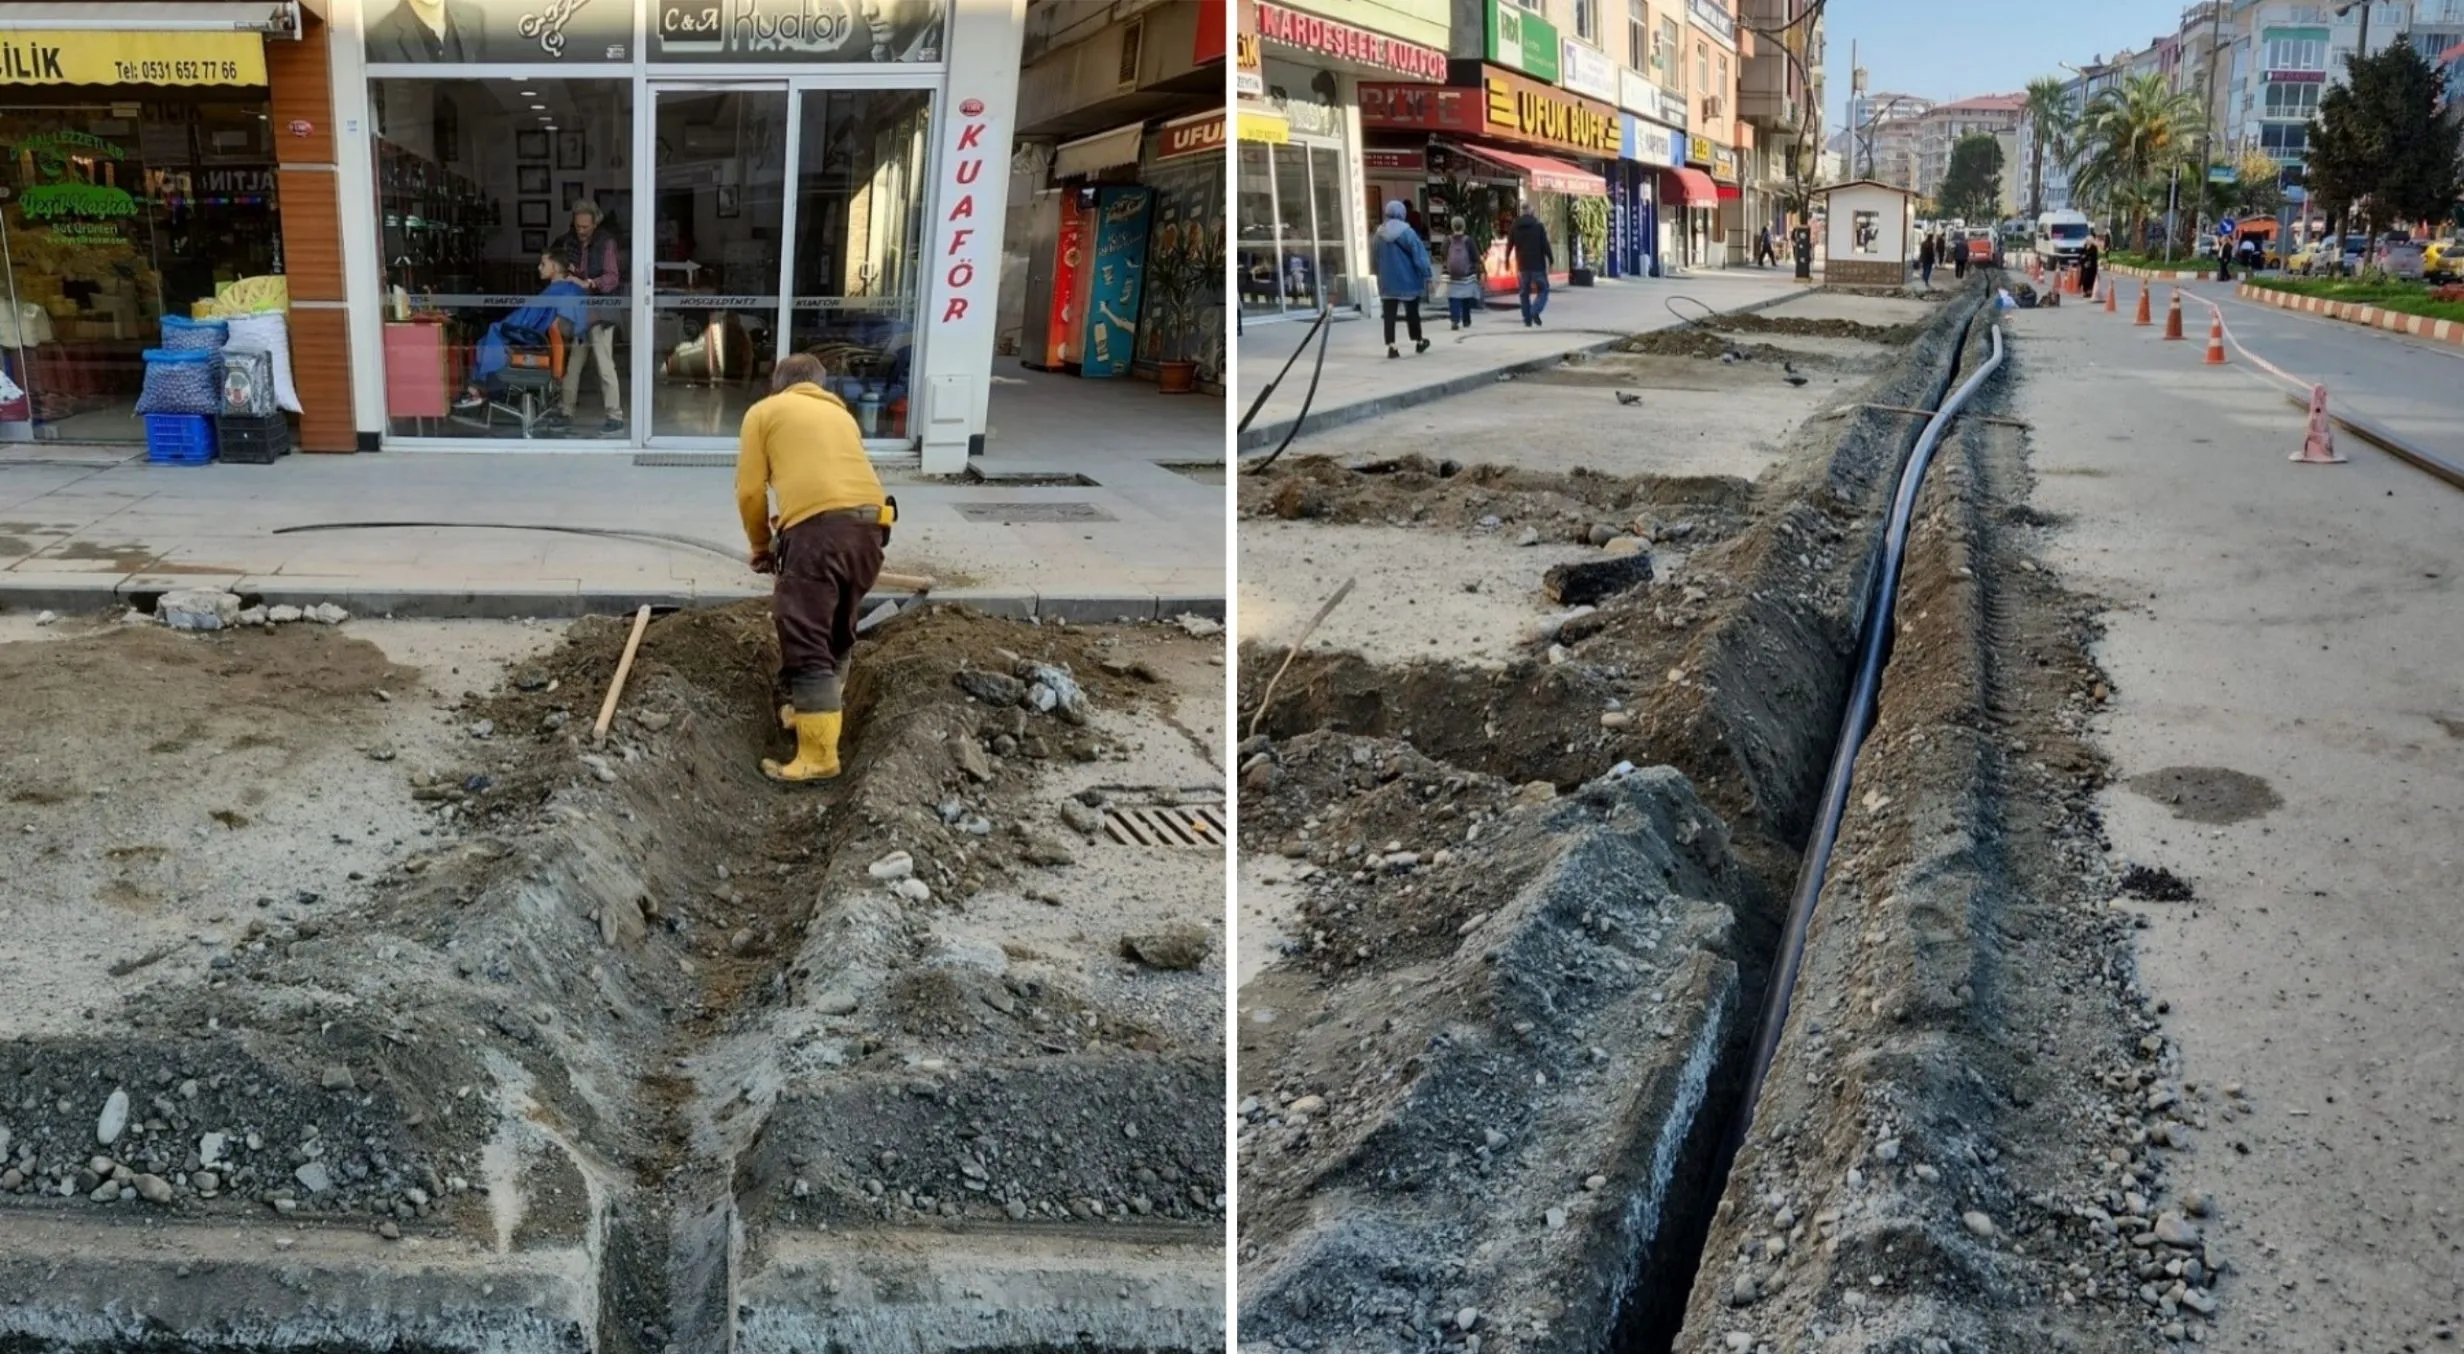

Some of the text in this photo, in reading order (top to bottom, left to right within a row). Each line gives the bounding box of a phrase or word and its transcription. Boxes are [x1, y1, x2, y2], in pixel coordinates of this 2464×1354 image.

[0, 42, 64, 78] İLİK
[115, 61, 237, 80] Tel: 0531 652 77 66
[1388, 38, 1448, 79] KUAFÖR
[1360, 87, 1462, 124] BÜFE
[1521, 91, 1567, 141] UFUK
[1569, 99, 1606, 151] BÜFE
[942, 123, 987, 323] KUAFÖR
